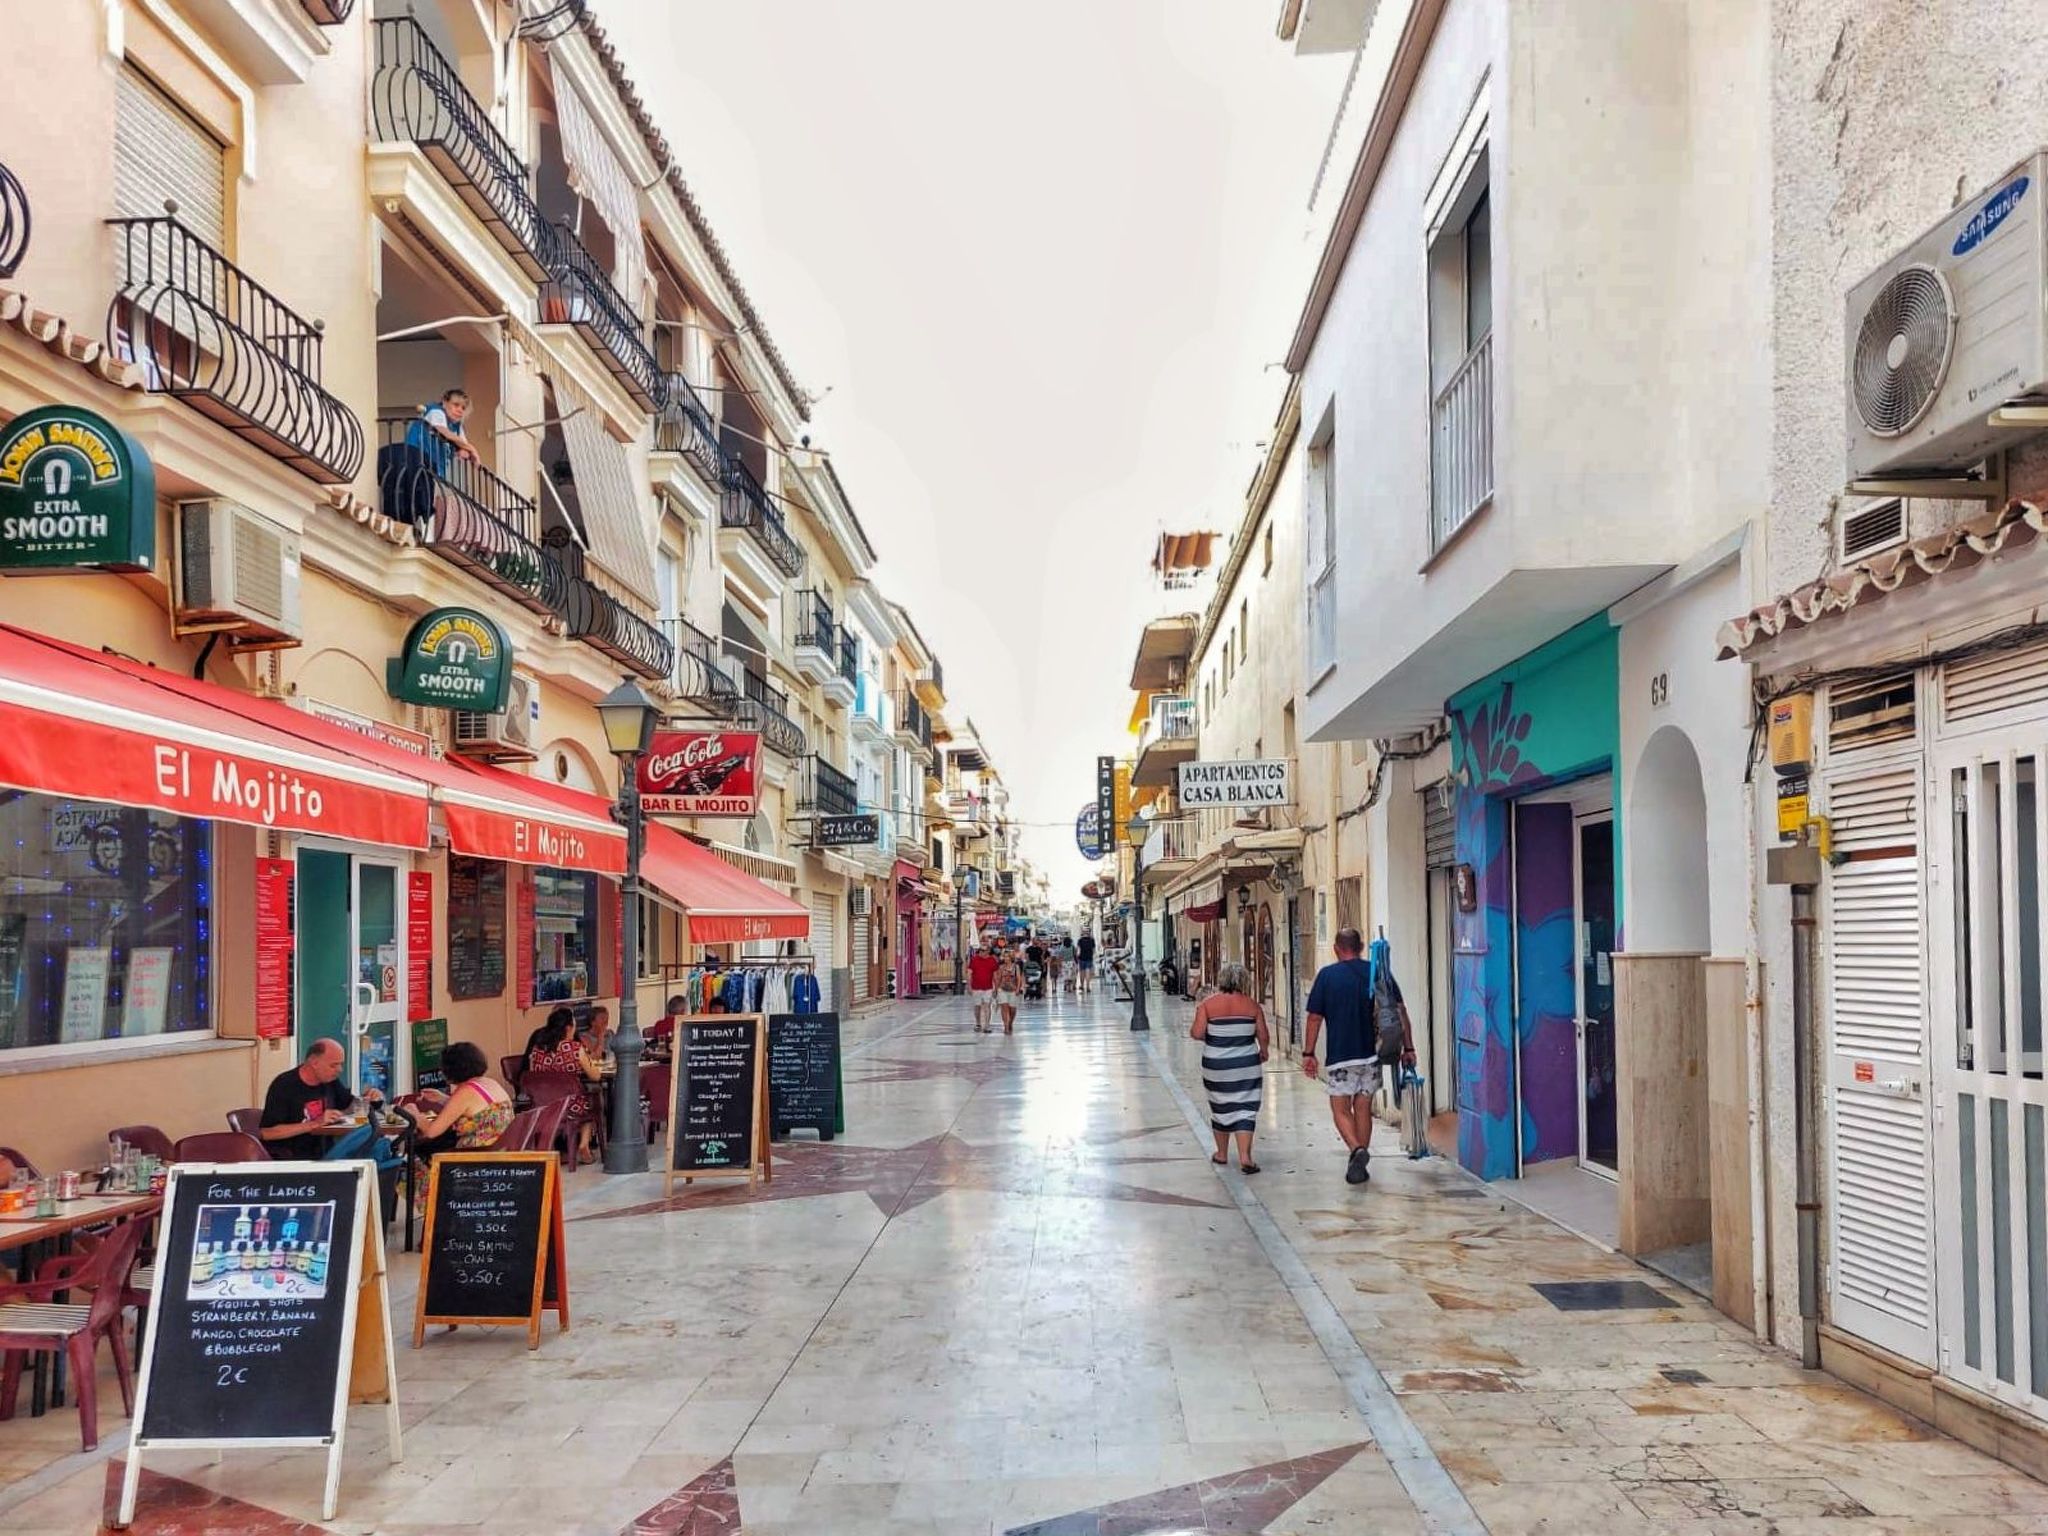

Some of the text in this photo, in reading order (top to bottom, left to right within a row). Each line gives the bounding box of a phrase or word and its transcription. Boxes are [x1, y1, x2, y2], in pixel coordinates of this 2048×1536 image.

[1961, 191, 2020, 242] SAMSUNG
[0, 427, 46, 482] JOHN
[33, 500, 81, 514] EXTRA
[4, 514, 108, 540] SMOOTH
[439, 665, 470, 676] EXTRA
[418, 673, 486, 694] SMOOTH
[1651, 673, 1668, 706] 69
[1183, 763, 1285, 783] APARTAMENTOS
[154, 744, 323, 825] El Mojito
[1183, 784, 1285, 802] CASA BLANCA
[642, 797, 749, 812] BAR EL MOJITO
[514, 821, 584, 865] El Mojito
[702, 1028, 736, 1038] TODAY
[207, 1183, 317, 1200] FOR THE LADIES
[208, 1299, 261, 1309] TEQUILA
[271, 1309, 317, 1321] BANANA
[238, 1327, 303, 1338] CHOCOLATE
